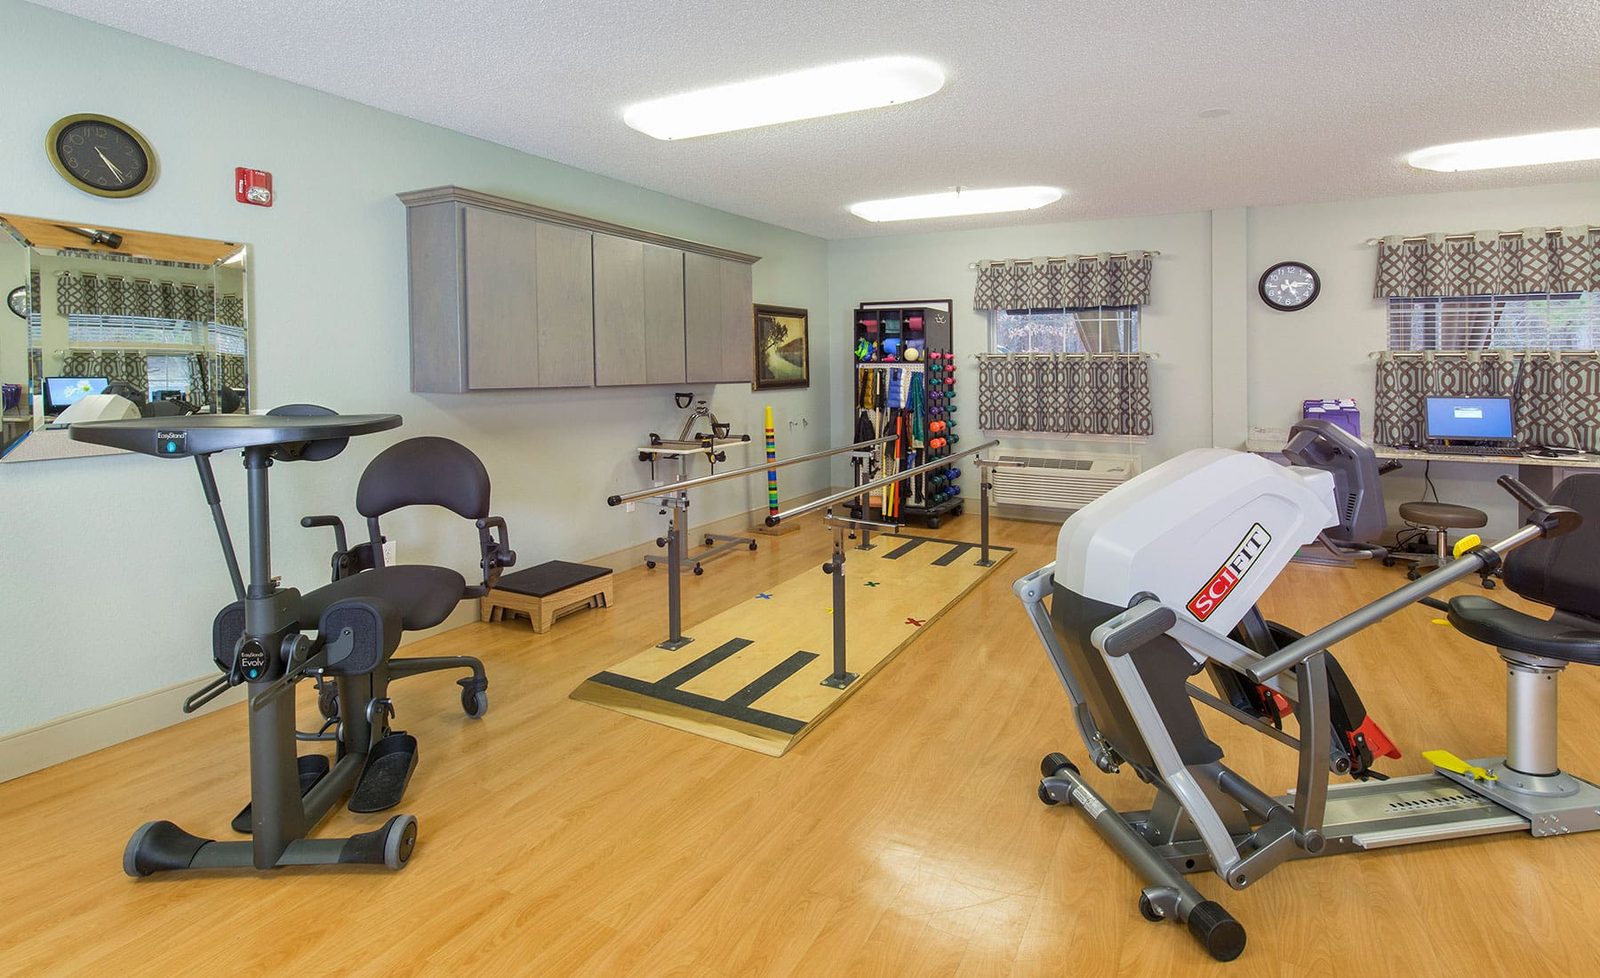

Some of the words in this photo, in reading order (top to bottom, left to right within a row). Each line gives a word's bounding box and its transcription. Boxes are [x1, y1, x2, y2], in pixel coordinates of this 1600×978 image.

[96, 127, 108, 138] 12
[1287, 266, 1296, 274] 12
[1194, 530, 1262, 615] SCIFIT
[241, 657, 265, 667] Evolv
